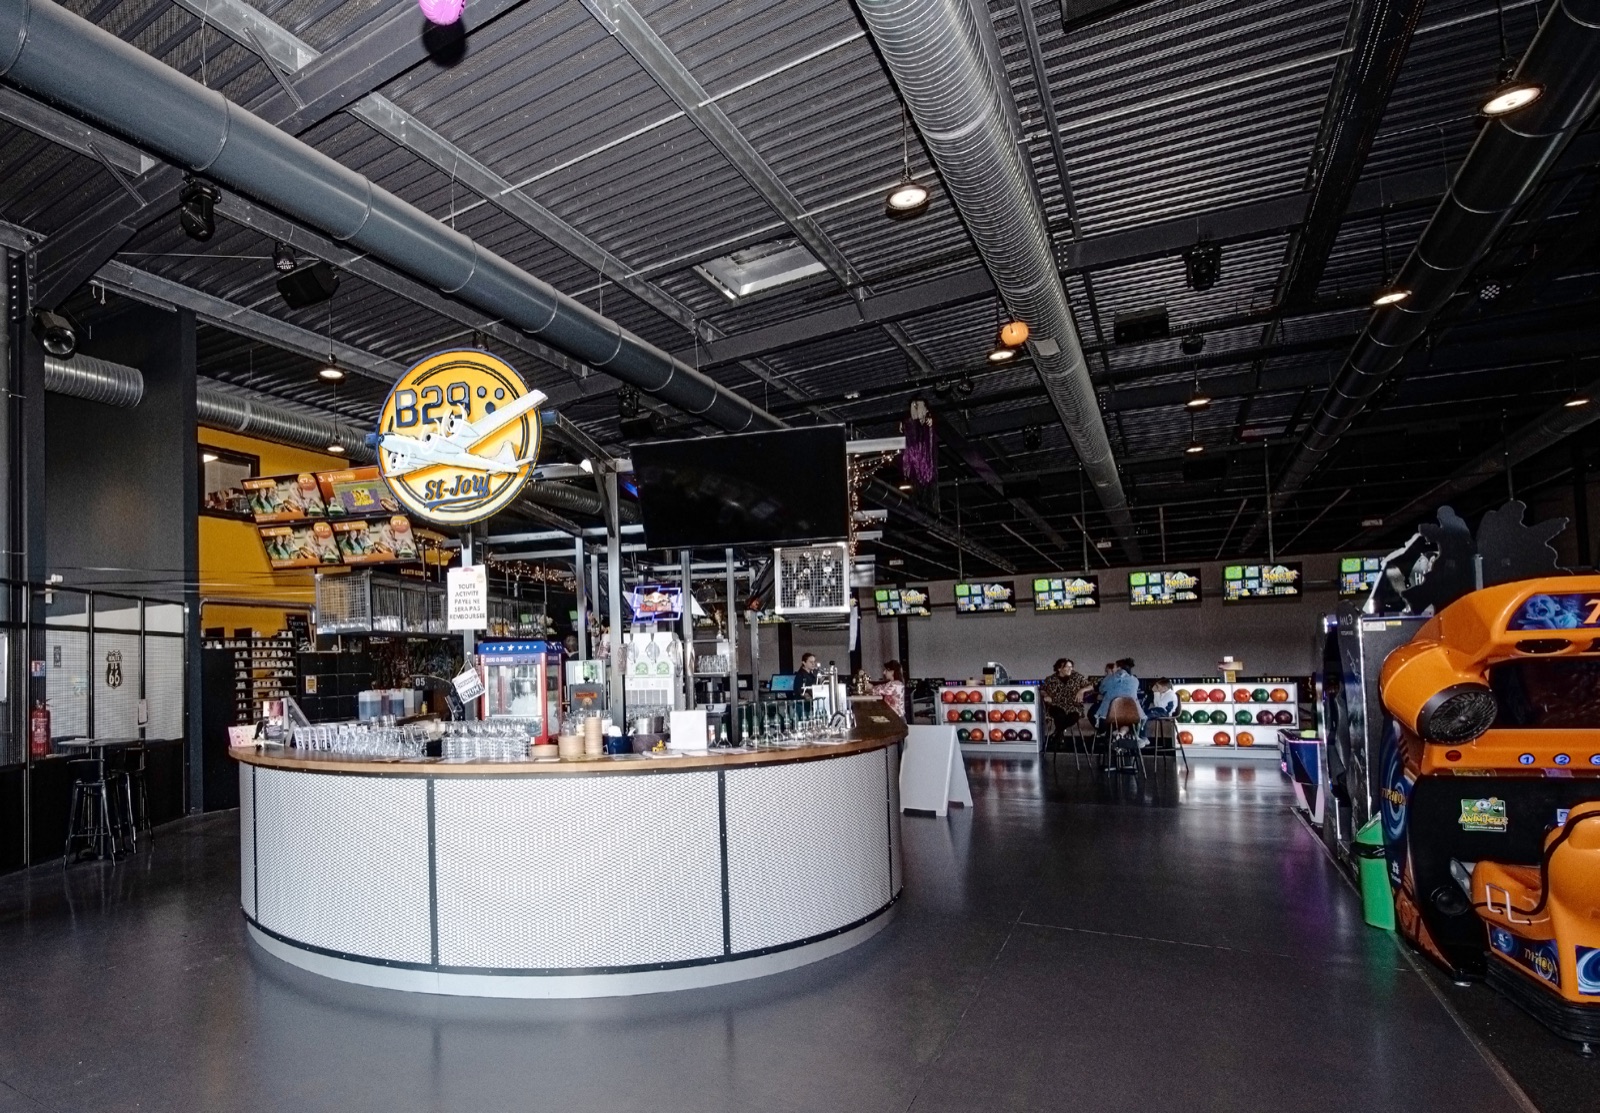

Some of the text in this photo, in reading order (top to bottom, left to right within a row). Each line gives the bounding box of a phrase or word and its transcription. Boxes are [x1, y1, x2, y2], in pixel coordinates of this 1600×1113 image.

[394, 381, 471, 428] B29
[425, 474, 491, 501] St-Jory
[108, 669, 120, 686] 66
[415, 677, 426, 687] 05
[1523, 756, 1530, 764] 1
[1559, 756, 1567, 764] 2
